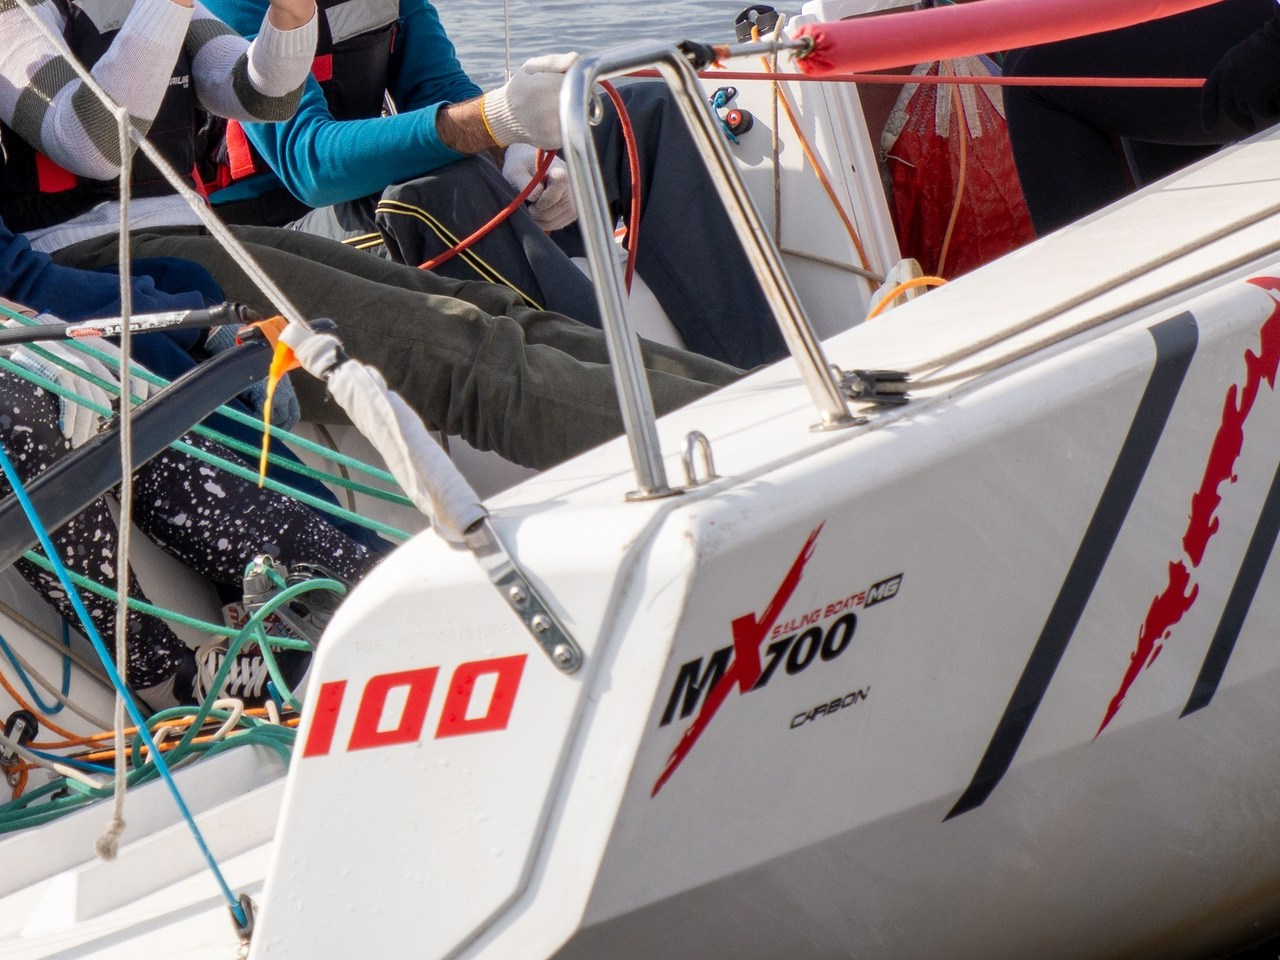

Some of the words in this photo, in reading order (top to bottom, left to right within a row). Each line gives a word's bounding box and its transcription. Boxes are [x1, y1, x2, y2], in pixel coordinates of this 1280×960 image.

[771, 608, 822, 639] SAILING
[824, 590, 866, 619] BOATS
[302, 653, 529, 759] 100
[789, 686, 871, 730] CARBON
